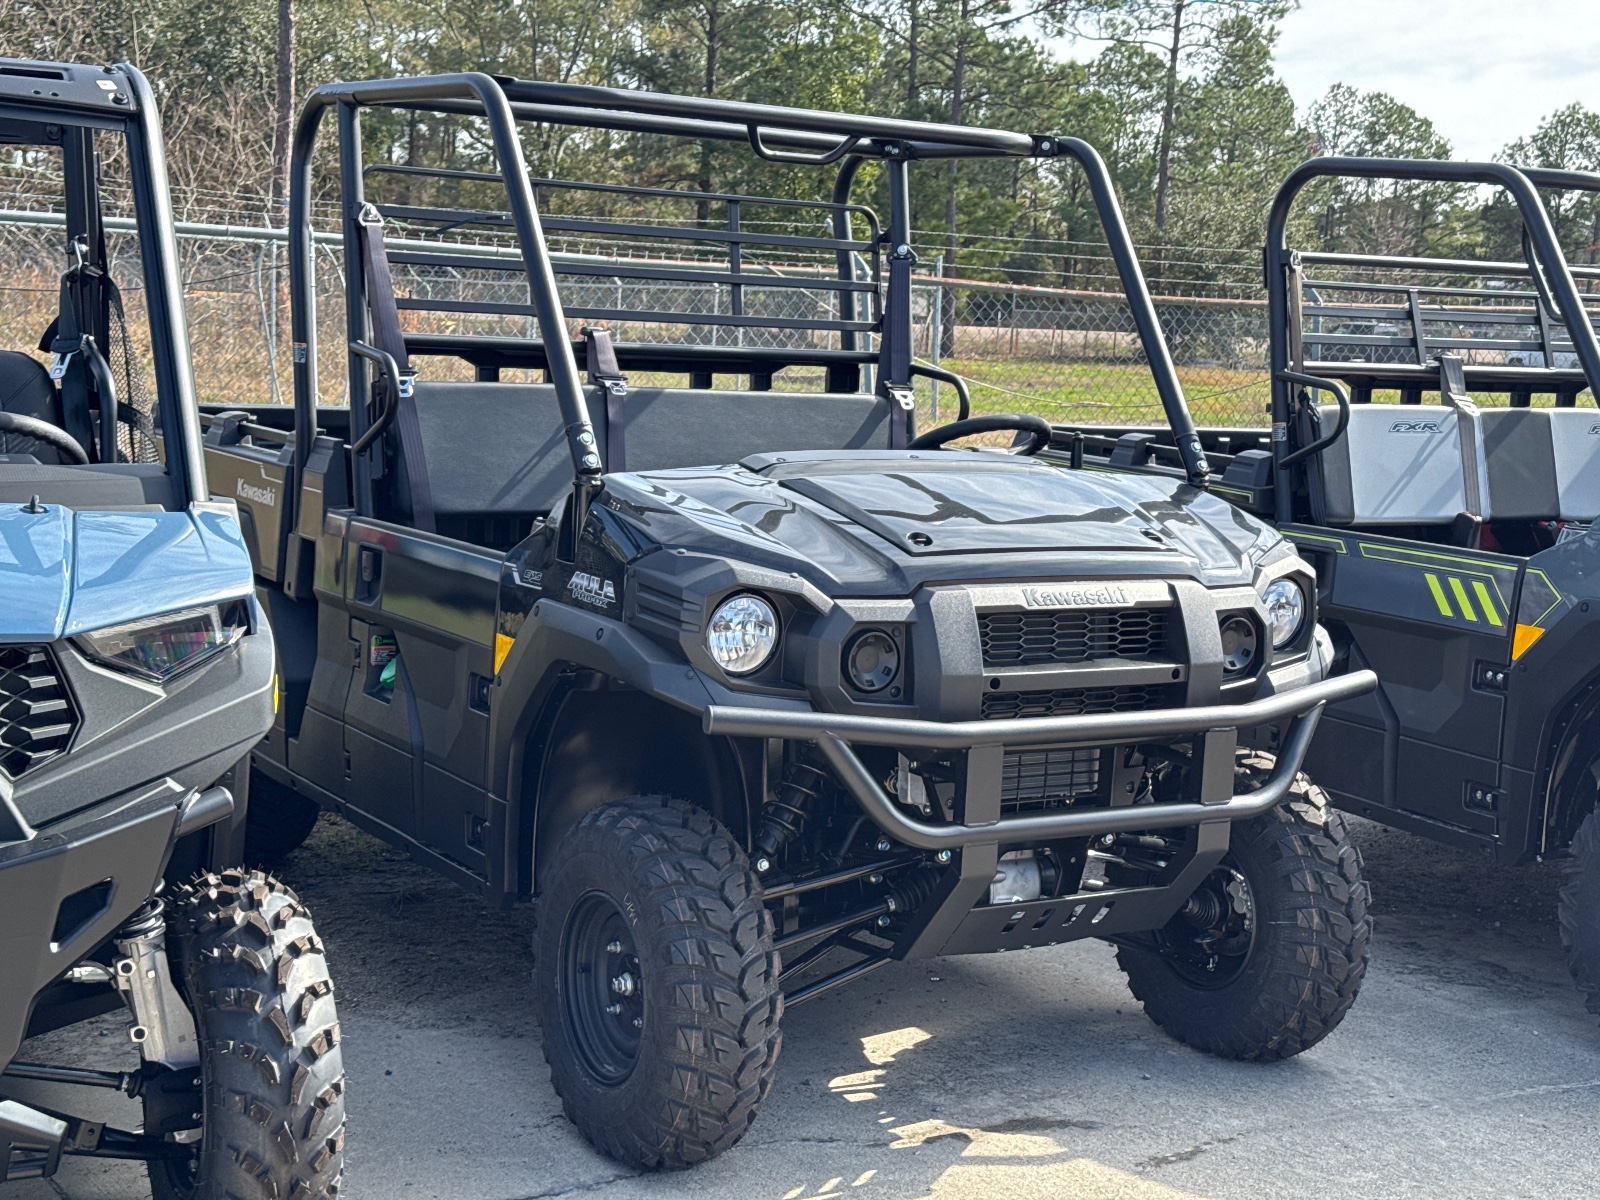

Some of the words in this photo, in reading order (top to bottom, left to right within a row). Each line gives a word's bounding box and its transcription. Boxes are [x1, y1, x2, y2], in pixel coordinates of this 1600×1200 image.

[1388, 420, 1442, 433] FXR
[237, 478, 275, 507] Kawasaki
[523, 569, 542, 580] EPS
[567, 571, 616, 602] MULE
[1022, 586, 1130, 607] Kawasaki
